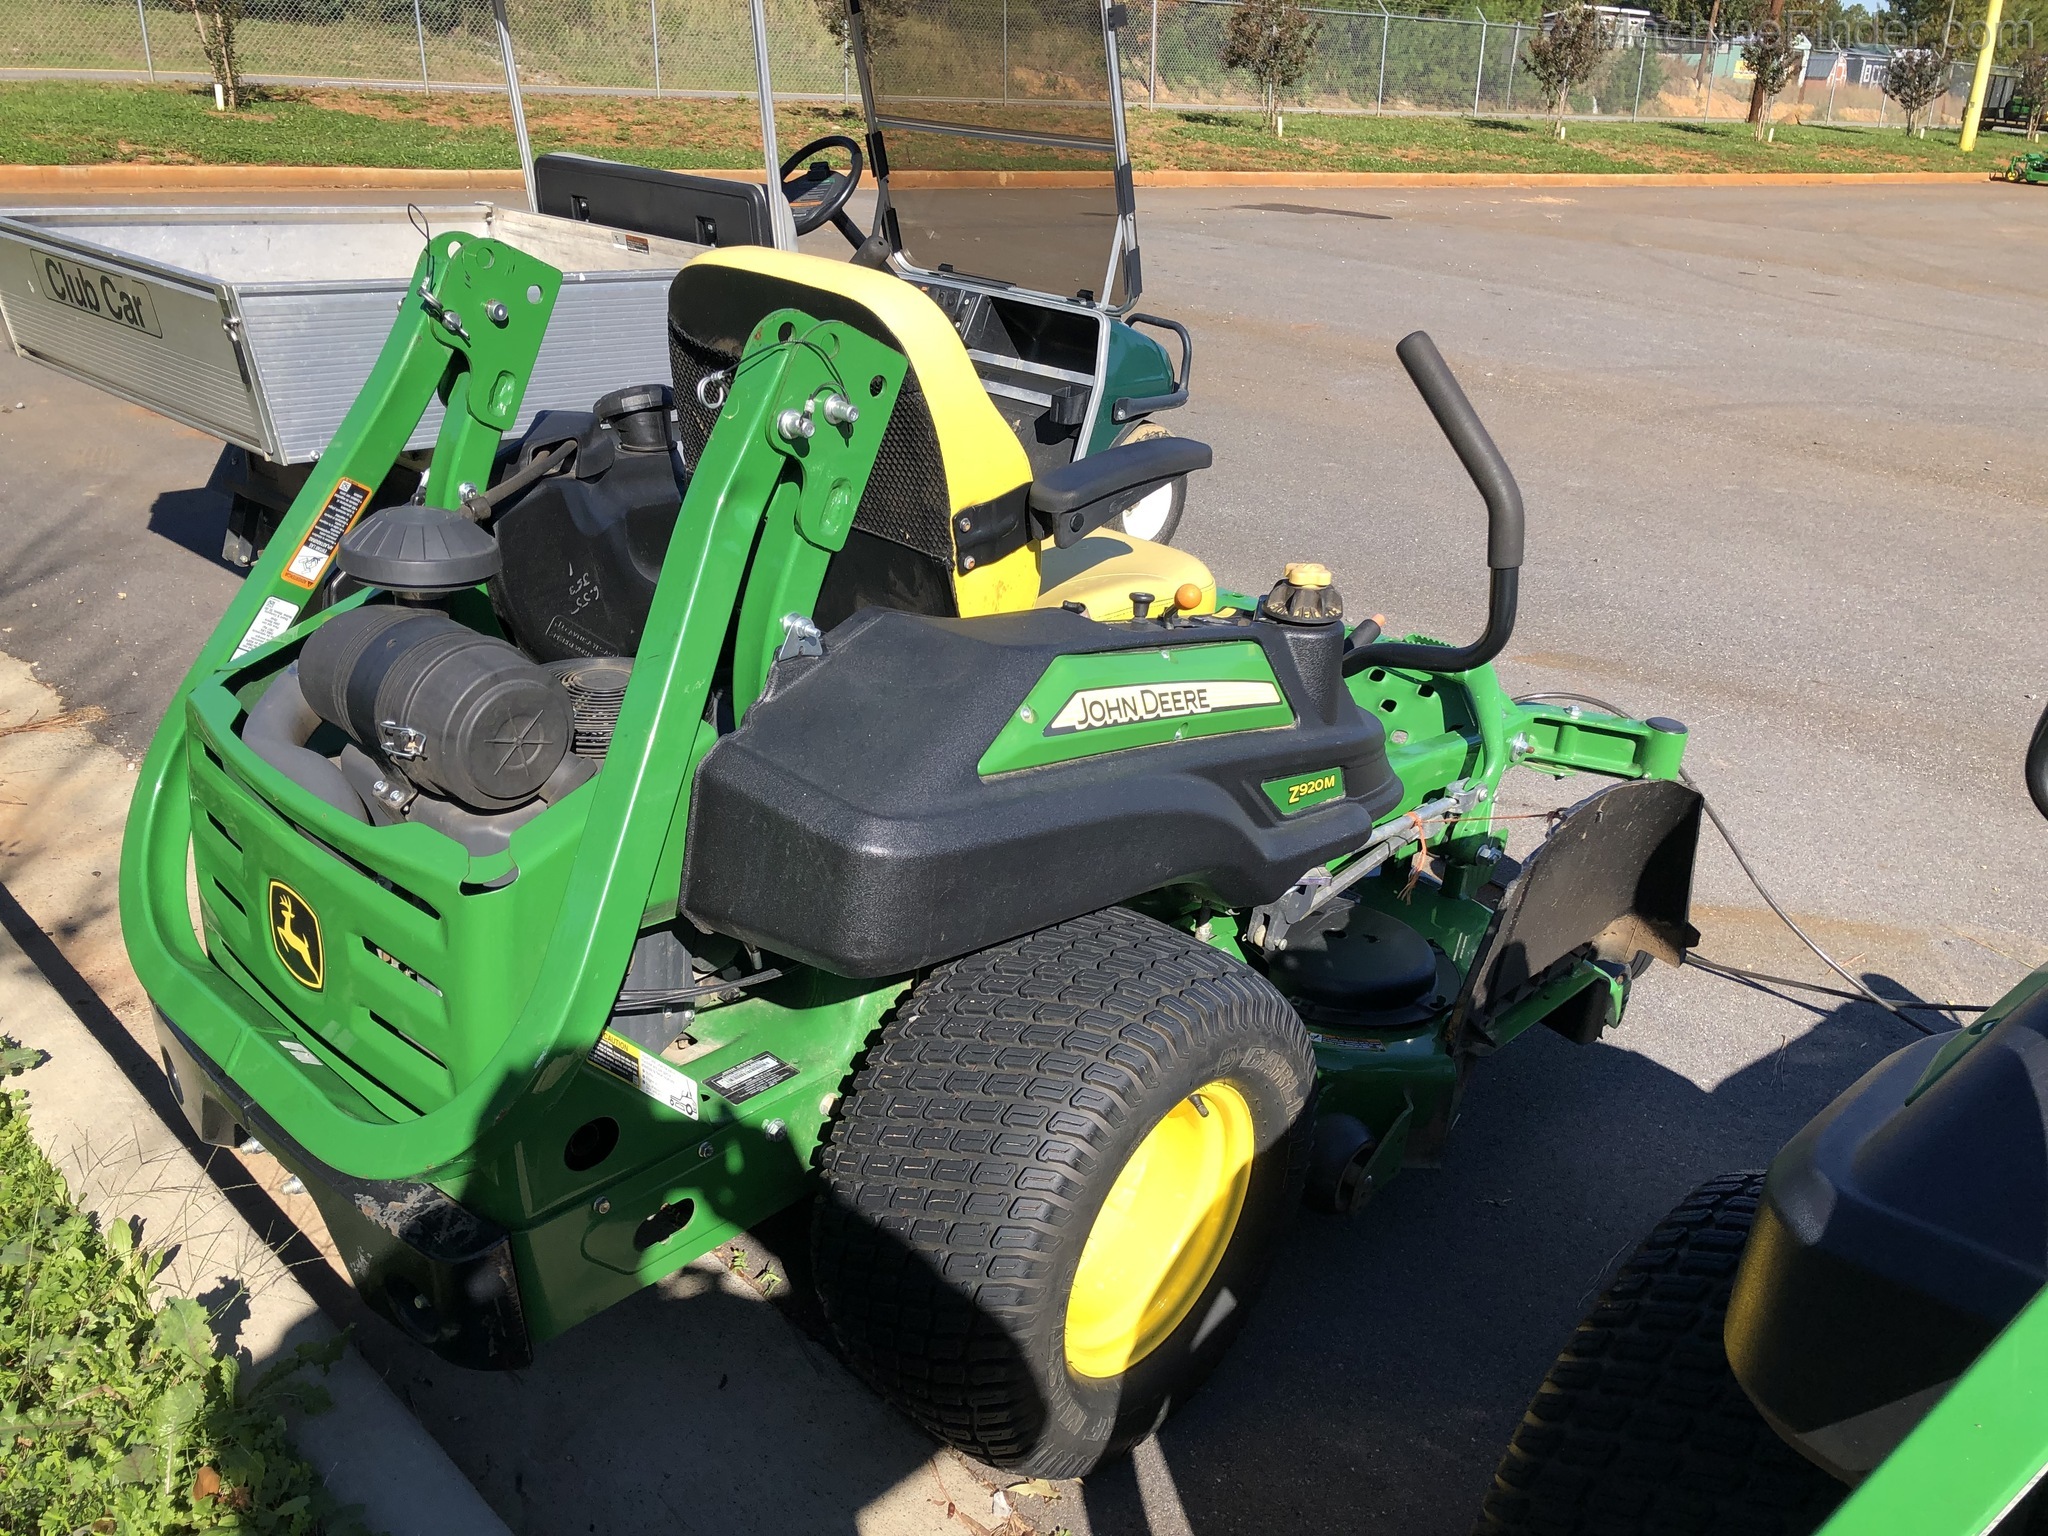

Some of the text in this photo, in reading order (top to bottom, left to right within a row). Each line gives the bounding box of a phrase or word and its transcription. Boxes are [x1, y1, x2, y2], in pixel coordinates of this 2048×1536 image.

[45, 258, 145, 329] Club Car
[1077, 688, 1210, 725] JOHN DEERE
[1288, 775, 1336, 804] Z920M
[603, 1032, 629, 1052] CAUTION
